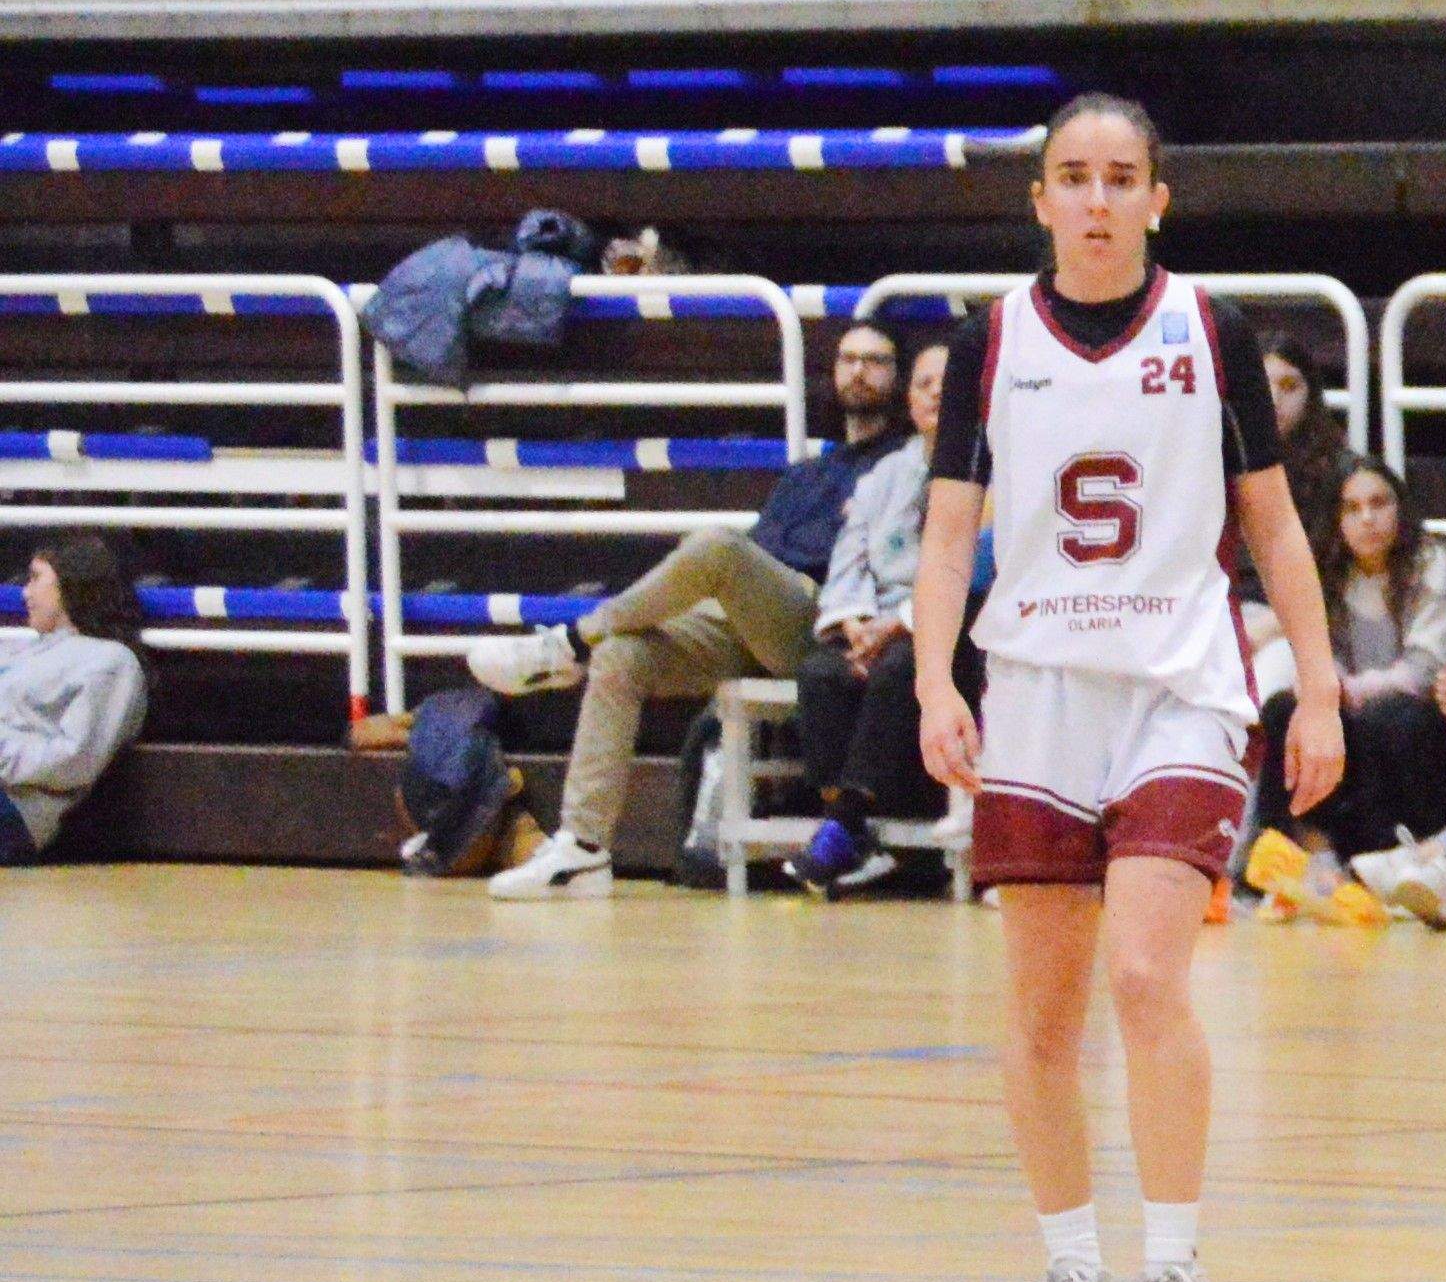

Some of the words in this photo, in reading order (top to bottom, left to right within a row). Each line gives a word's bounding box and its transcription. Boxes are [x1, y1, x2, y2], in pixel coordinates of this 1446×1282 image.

[1139, 354, 1197, 395] 24
[1054, 449, 1144, 569] S
[1040, 593, 1179, 616] INTERSPORT
